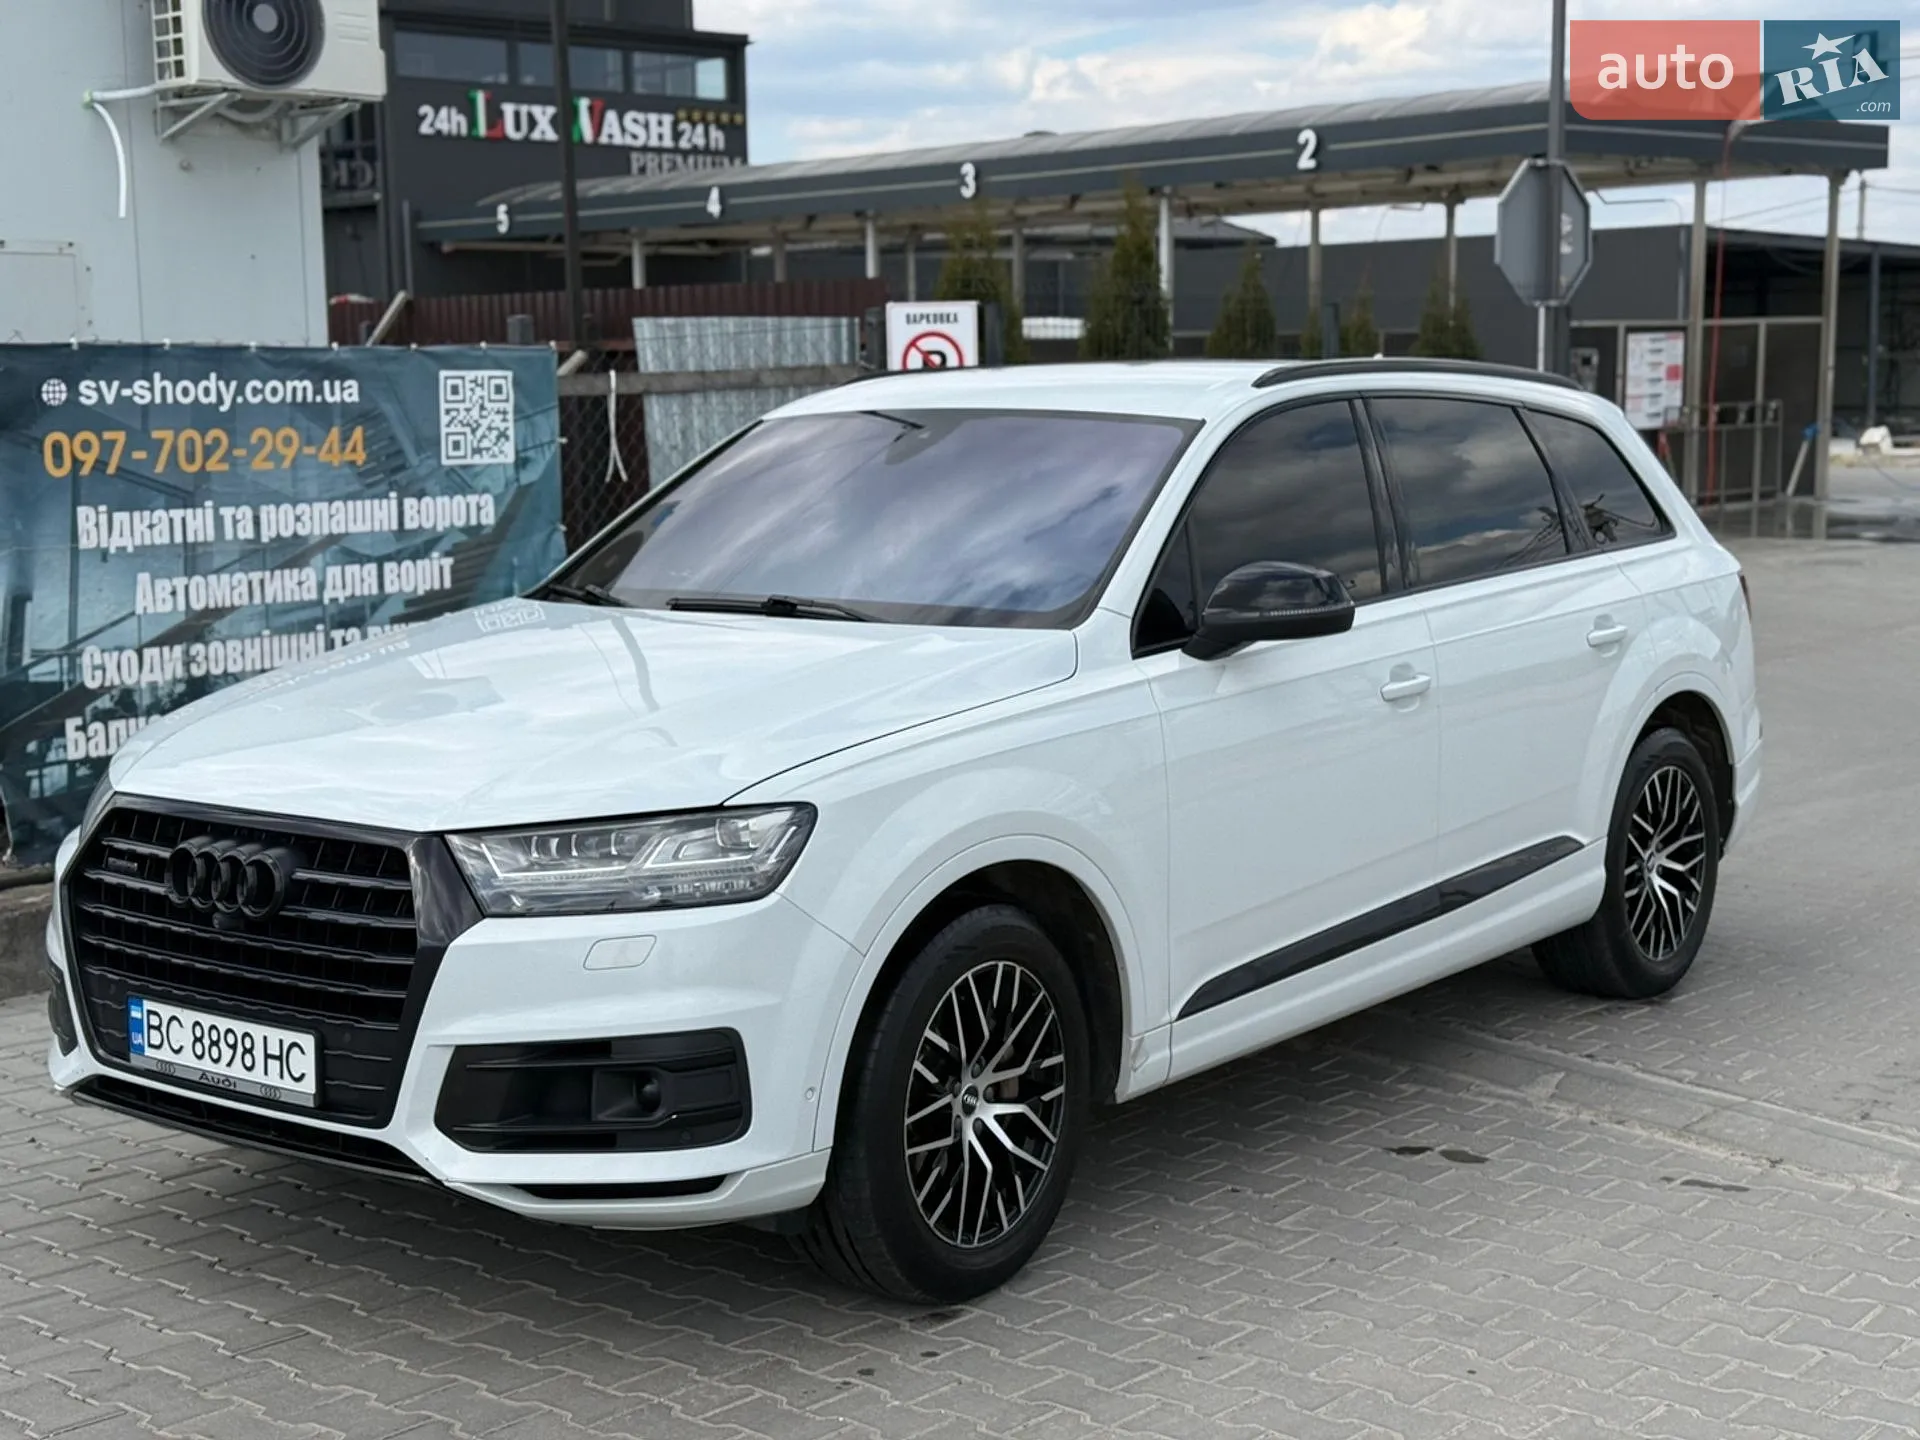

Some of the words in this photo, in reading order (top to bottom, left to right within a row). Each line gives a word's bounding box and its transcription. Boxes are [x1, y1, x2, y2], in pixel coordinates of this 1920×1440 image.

[418, 104, 467, 137] 24h
[467, 90, 559, 142] LUX
[572, 97, 675, 148] WASH
[676, 121, 725, 151] 24h
[1297, 128, 1318, 171] 2
[706, 185, 722, 219] 4
[960, 161, 977, 199] 3
[496, 203, 510, 235] 5
[78, 371, 360, 412] sv-shody.com.ua
[43, 426, 366, 478] 097-702-29-44
[76, 501, 214, 553] Відкатні
[219, 507, 254, 542] та
[260, 492, 400, 543] розпашні
[403, 493, 495, 531] ворота
[136, 564, 318, 615] Автоматика
[323, 565, 377, 604] для
[384, 551, 454, 595] воріт
[81, 642, 184, 691] Сходи
[189, 623, 327, 677] зовнішні
[131, 1031, 144, 1045] UA
[146, 1009, 184, 1055] BC
[191, 1020, 256, 1072] 8898
[262, 1034, 307, 1083] HC
